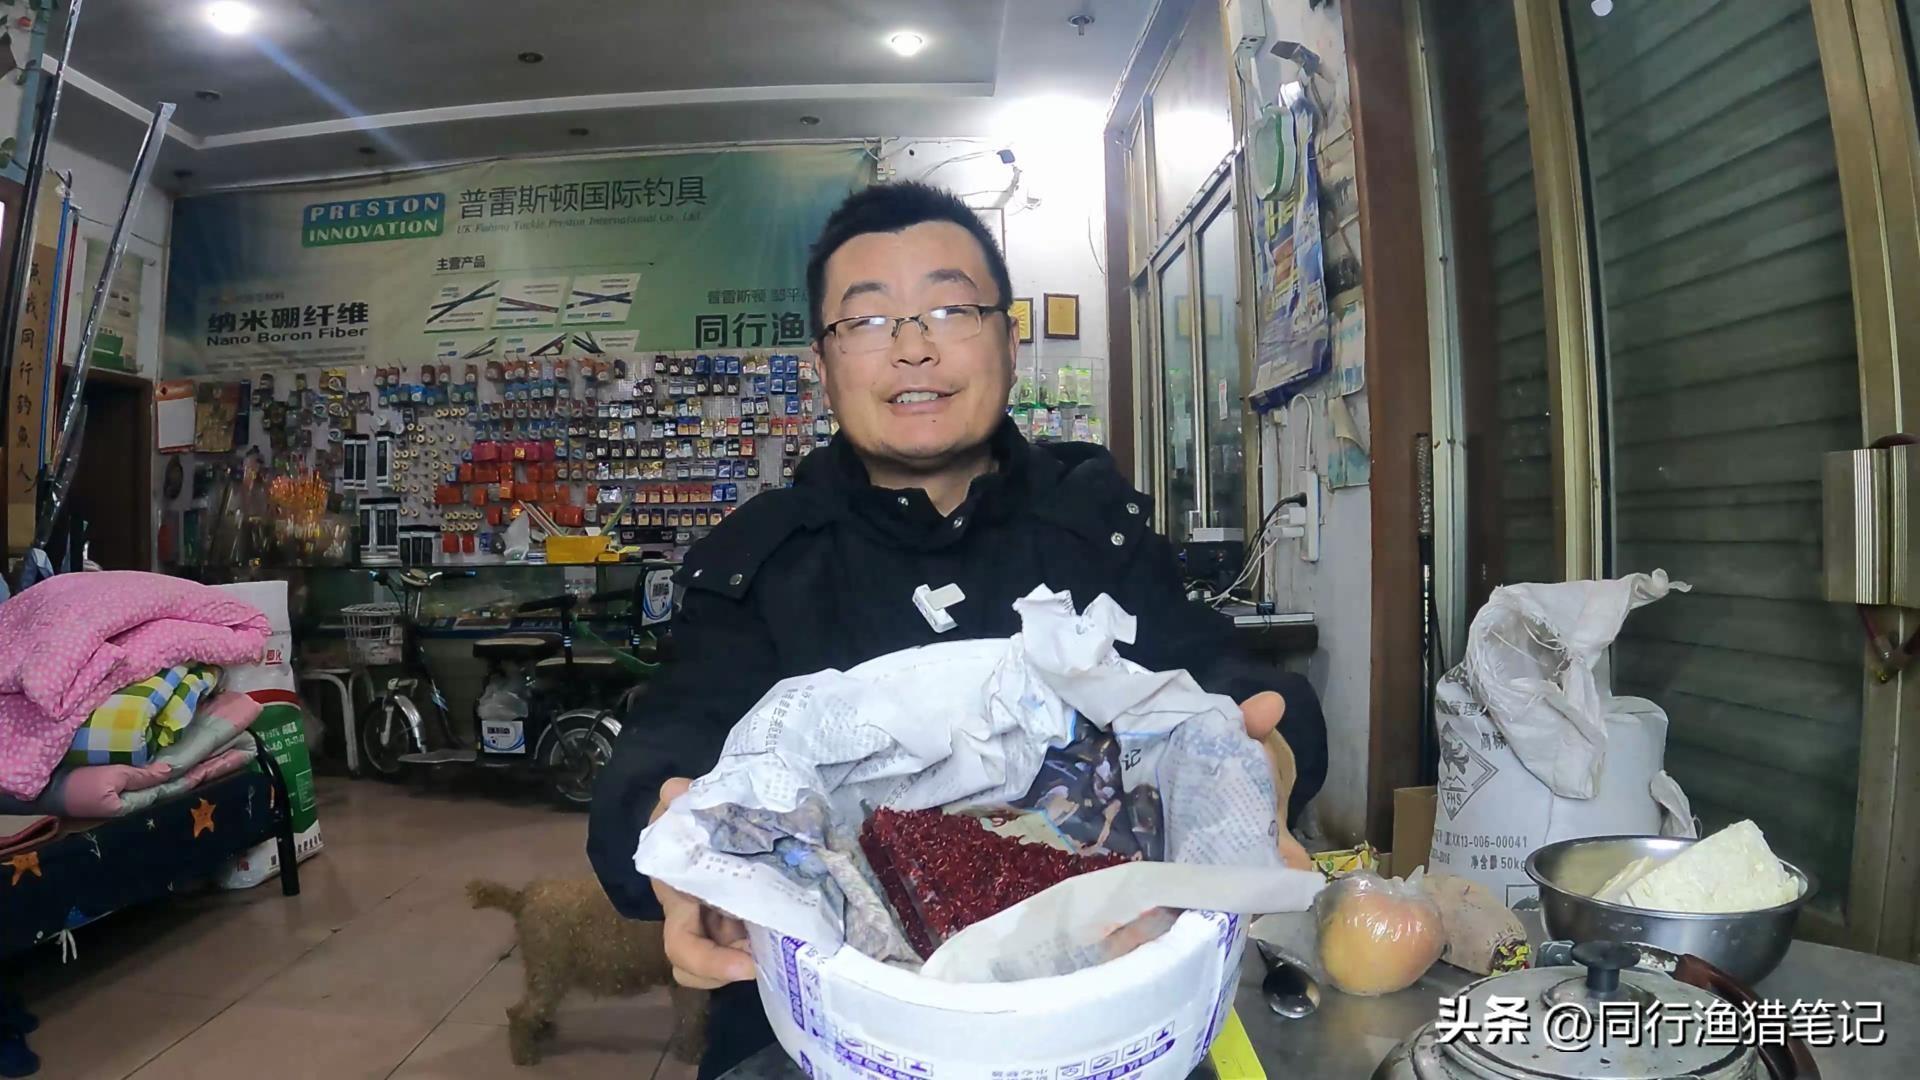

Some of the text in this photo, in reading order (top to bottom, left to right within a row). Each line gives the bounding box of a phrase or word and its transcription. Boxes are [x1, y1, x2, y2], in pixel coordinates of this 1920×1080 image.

[310, 196, 440, 222] PRESTON
[459, 176, 707, 219] 普雷斯顿国际钓具
[309, 219, 438, 242] INNOVATION
[437, 256, 485, 271] 主营产品
[207, 302, 369, 333] 纳米硼纤维
[207, 327, 369, 347] Nano Boron Fiber
[1446, 792, 1462, 806] FHS
